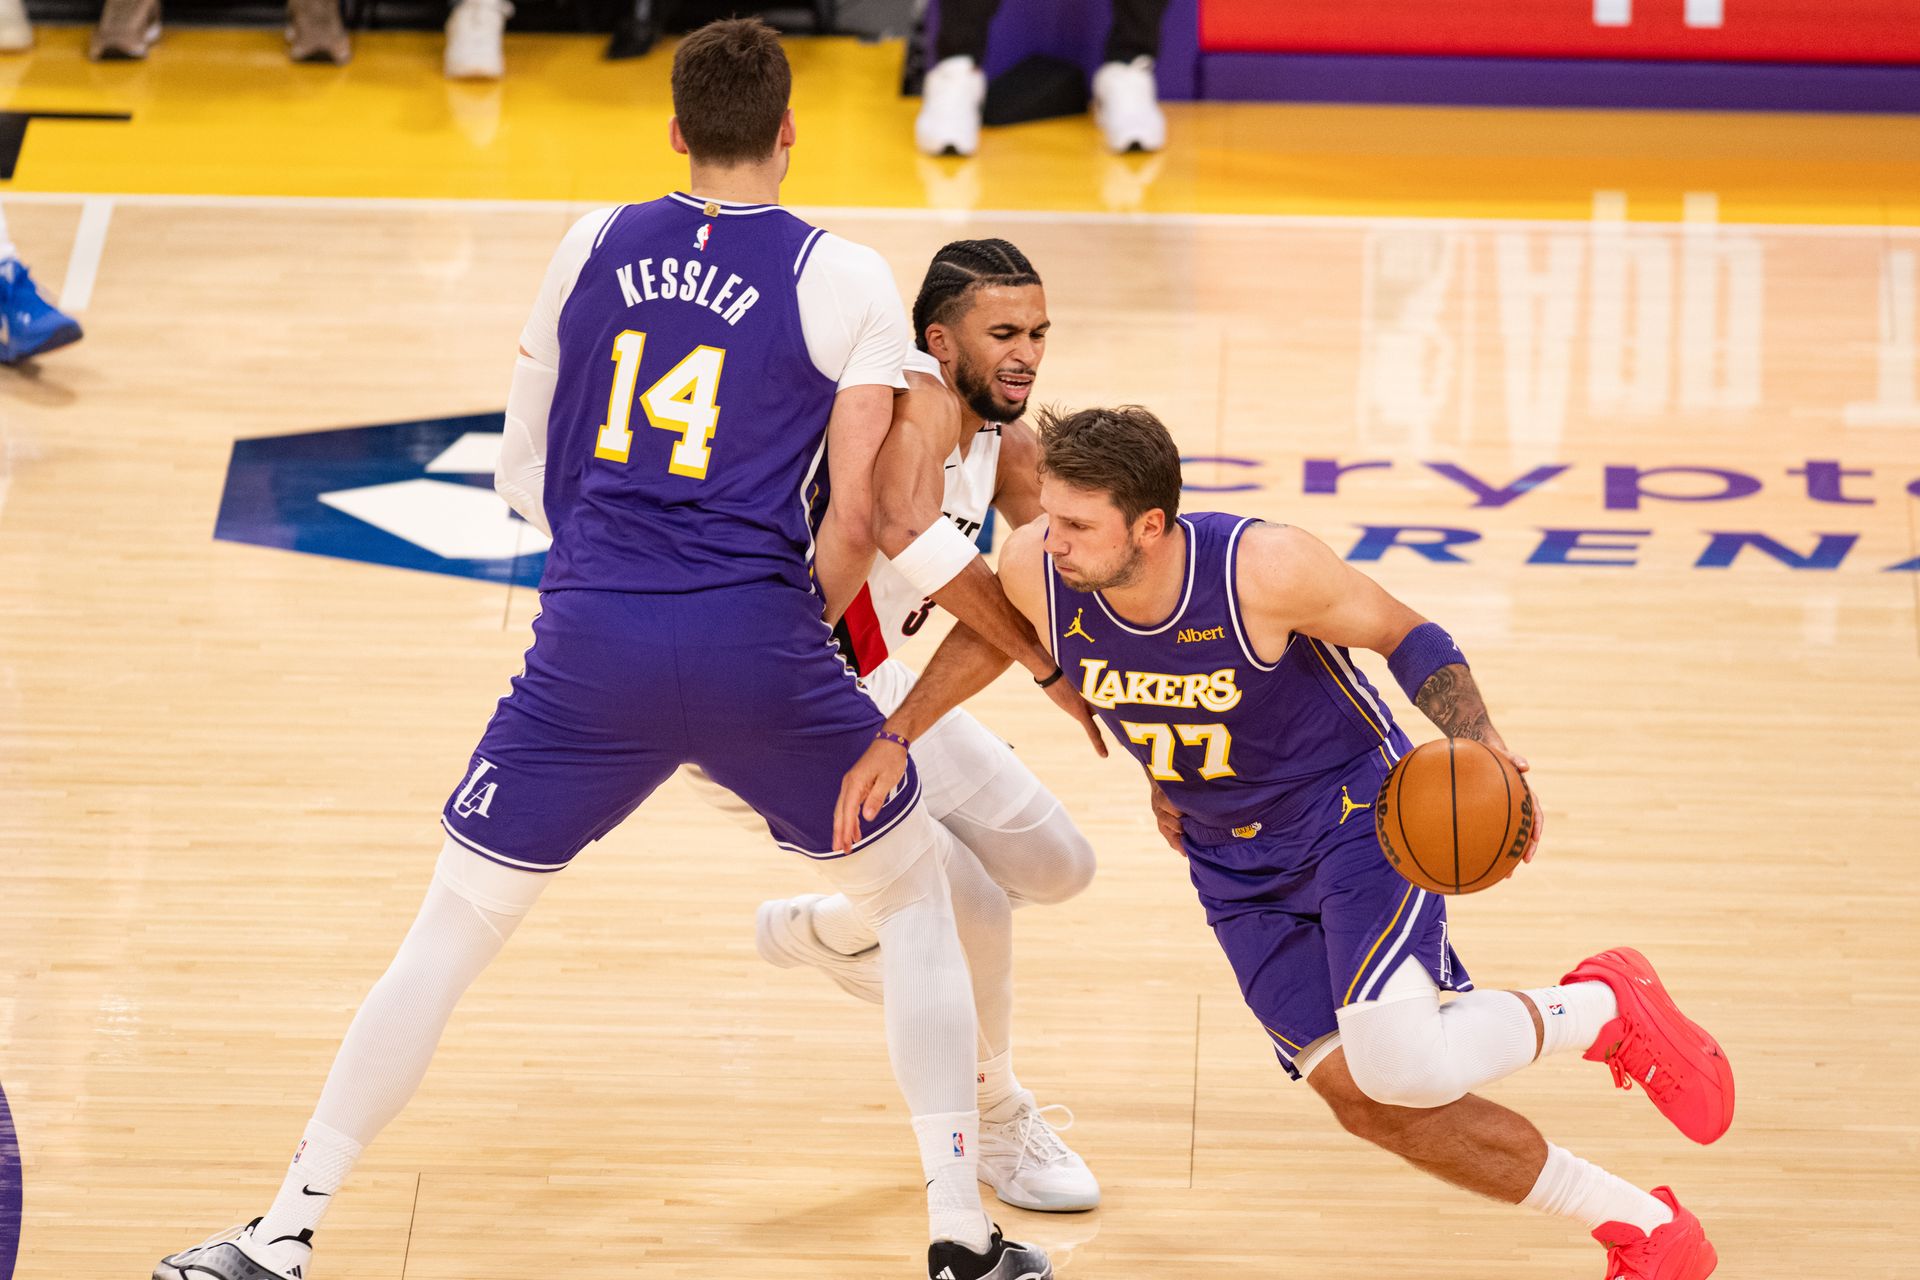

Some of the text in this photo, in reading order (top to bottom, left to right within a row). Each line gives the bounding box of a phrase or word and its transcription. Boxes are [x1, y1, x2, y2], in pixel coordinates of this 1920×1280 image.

[615, 257, 760, 327] KESSLER
[594, 329, 726, 480] 14
[1180, 457, 1920, 510] crypt
[1343, 523, 1920, 573] REN
[1176, 625, 1226, 644] Albert
[1079, 658, 1243, 713] LAKERS
[1120, 719, 1238, 782] 77
[453, 757, 498, 819] LA
